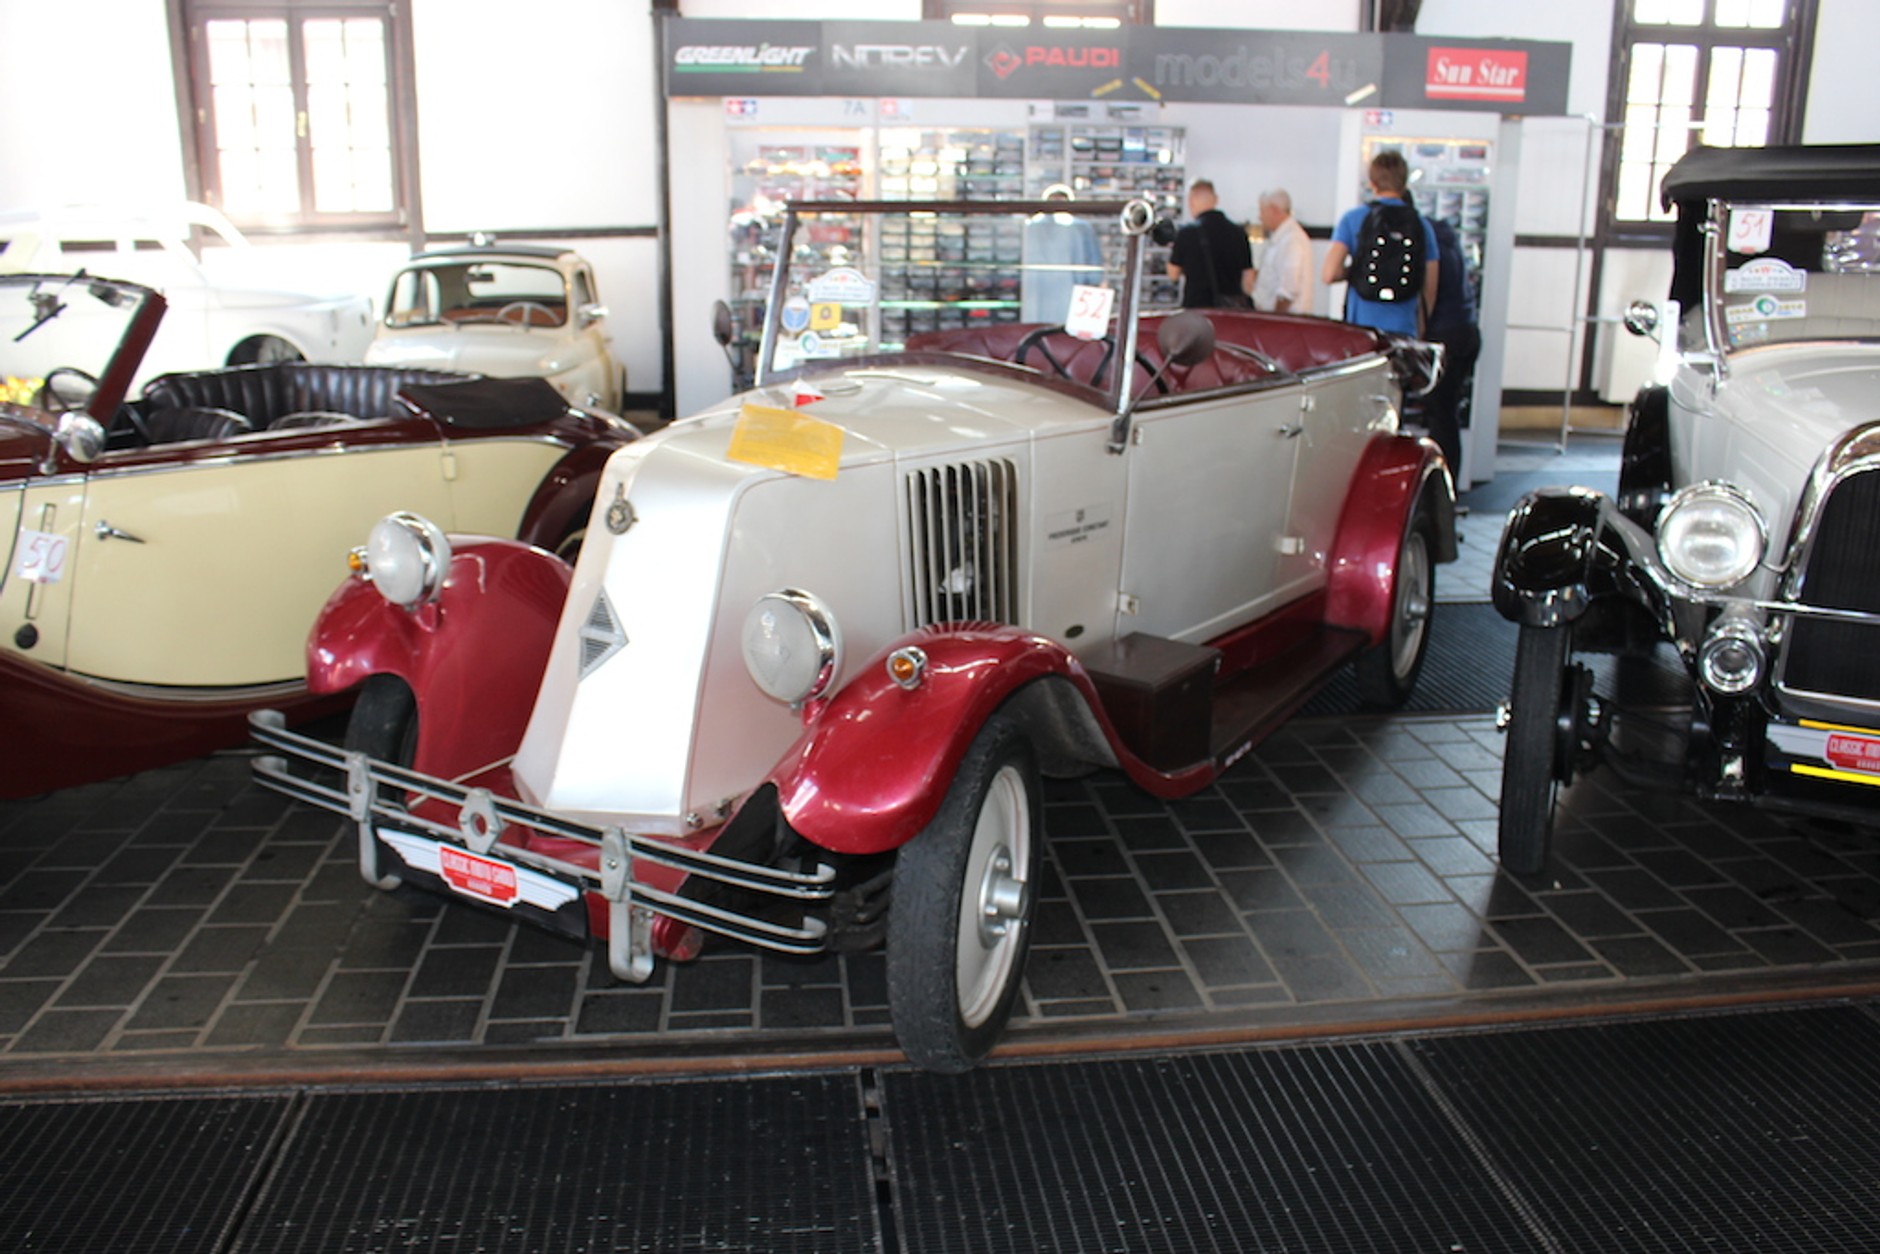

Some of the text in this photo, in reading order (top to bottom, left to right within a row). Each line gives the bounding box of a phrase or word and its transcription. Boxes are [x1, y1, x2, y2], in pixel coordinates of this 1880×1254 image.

[832, 44, 967, 68] NOREV
[1025, 46, 1120, 67] PAUDI
[1154, 45, 1357, 90] models4u
[1433, 56, 1519, 86] Sun Star
[1735, 212, 1765, 239] 51
[1075, 290, 1106, 319] 52
[24, 536, 65, 573] 50
